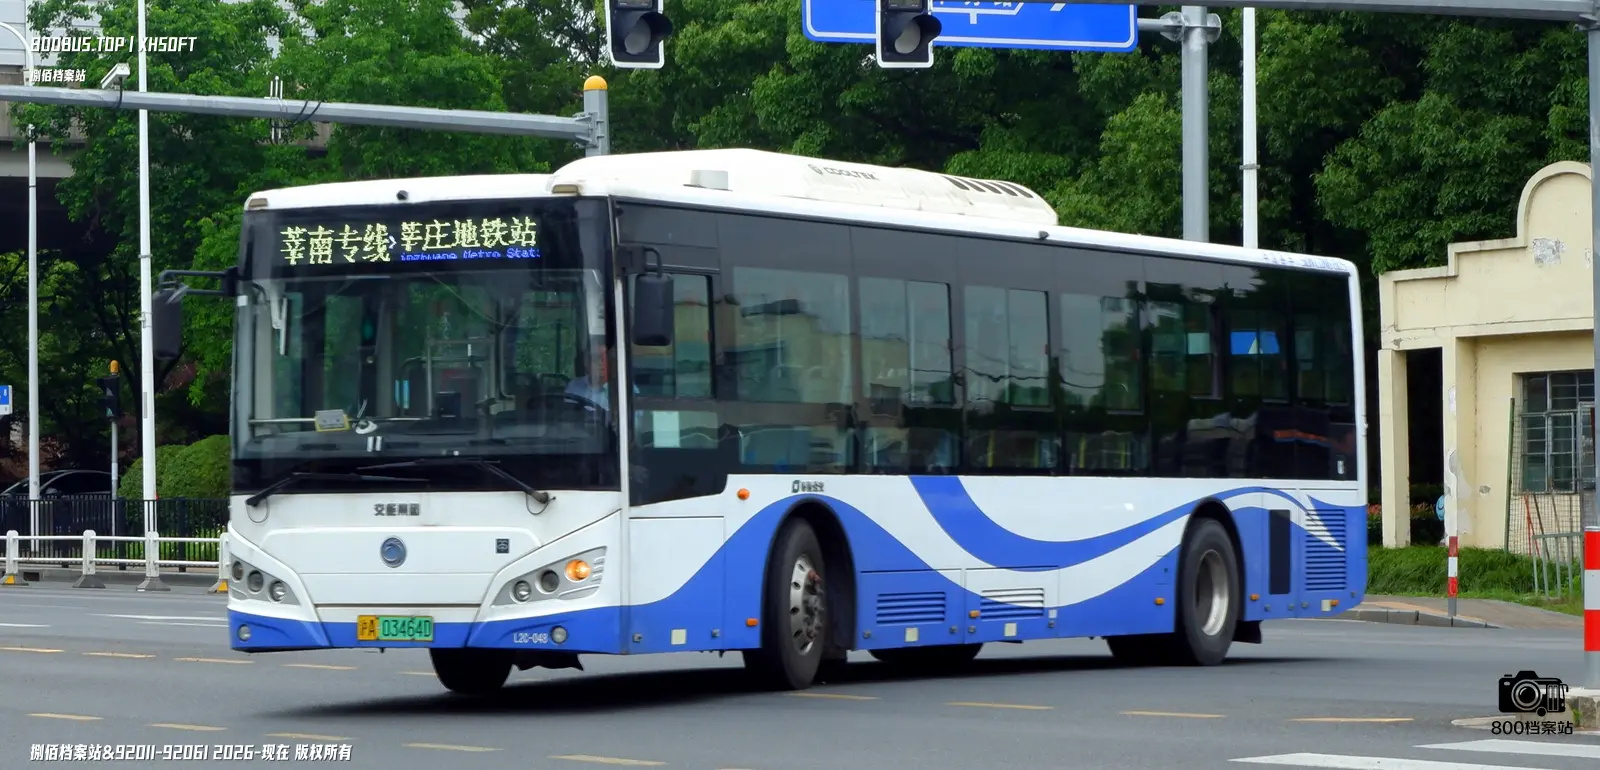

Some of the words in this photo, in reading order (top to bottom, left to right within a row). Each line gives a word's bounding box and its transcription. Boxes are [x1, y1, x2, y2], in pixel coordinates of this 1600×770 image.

[823, 166, 880, 181] COOLTEK
[280, 223, 391, 266] 莘南专线
[400, 216, 537, 252] 莘庄地铁站
[382, 619, 432, 638] 03464D
